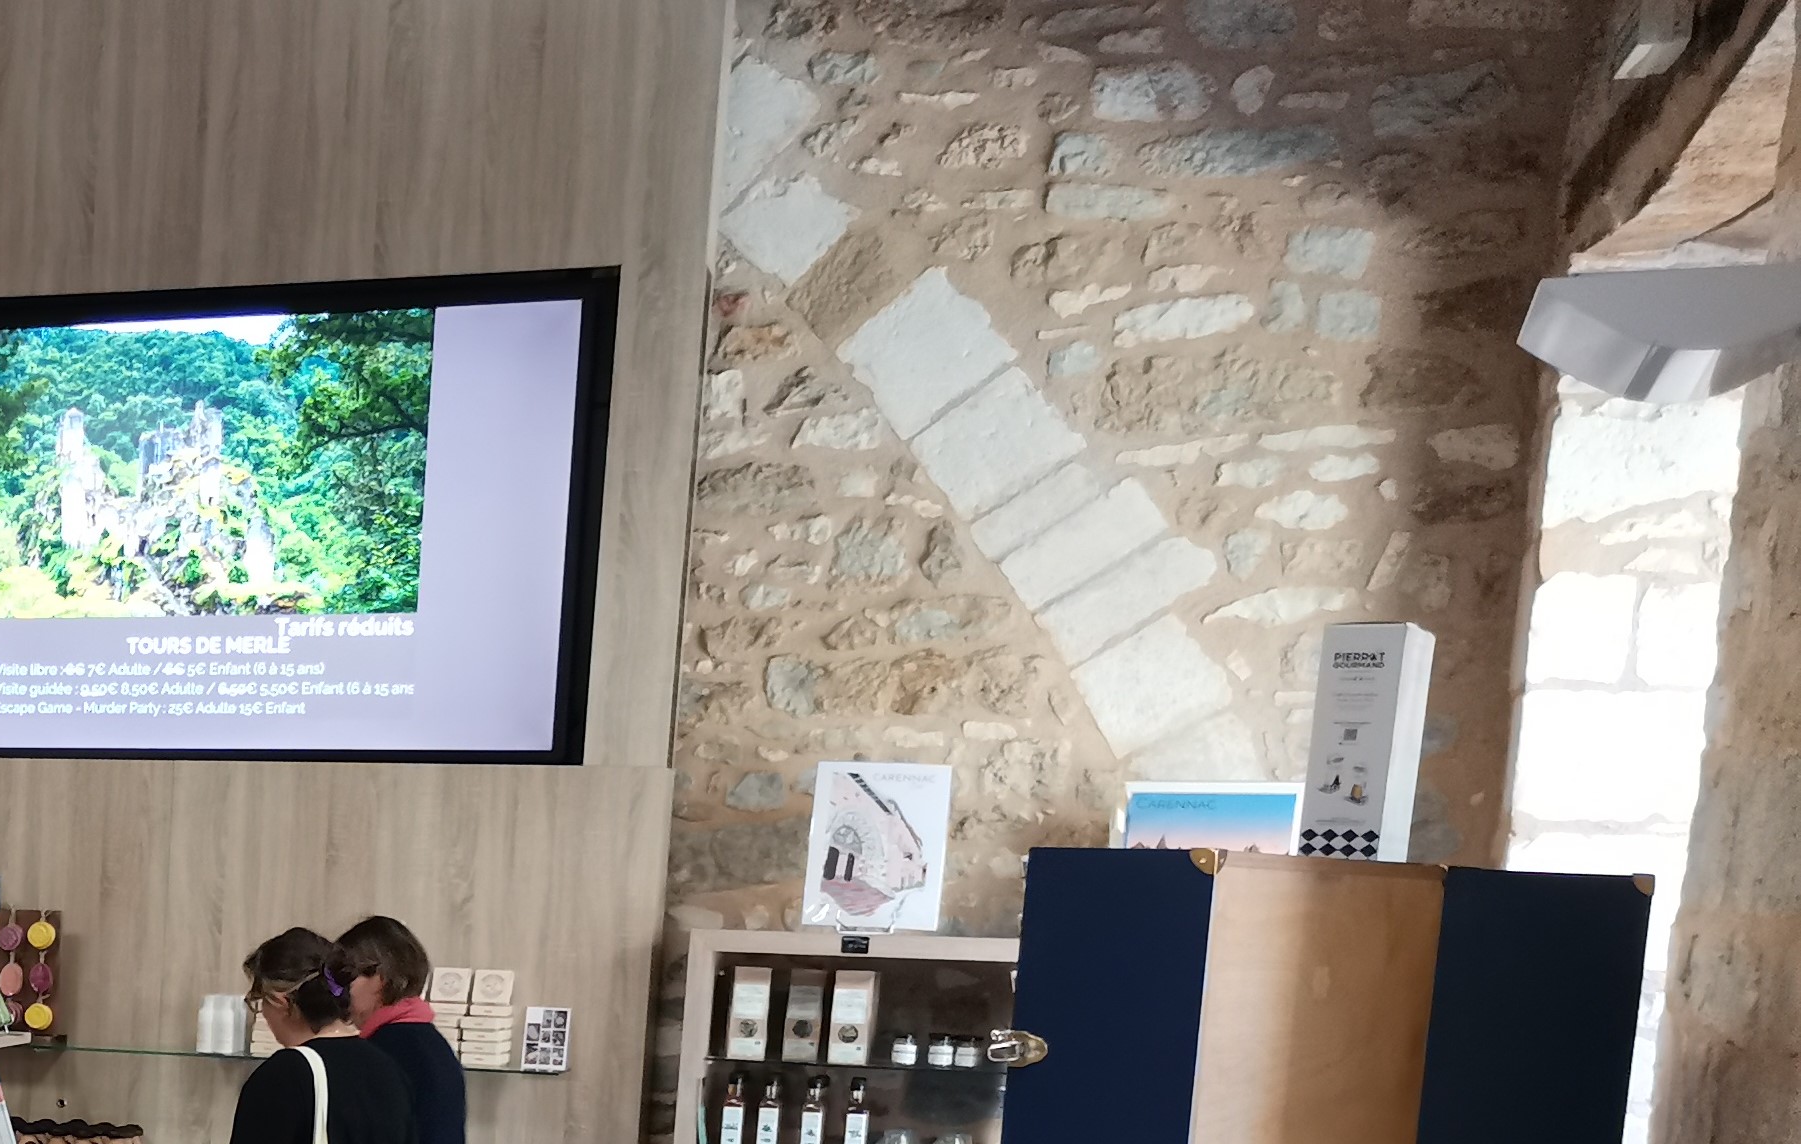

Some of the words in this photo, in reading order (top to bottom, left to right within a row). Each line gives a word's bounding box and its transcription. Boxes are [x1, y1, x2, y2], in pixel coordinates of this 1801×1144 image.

[274, 617, 334, 637] Tarifs
[338, 616, 415, 637] réduits
[126, 636, 192, 655] TOURS
[195, 636, 222, 654] DE
[225, 635, 291, 654] MERLE
[30, 662, 58, 676] libre
[87, 662, 106, 677] 7€
[108, 662, 151, 676] Adulte
[187, 662, 207, 677] 5€
[209, 661, 251, 676] Enfant
[280, 662, 295, 677] 15
[297, 661, 326, 677] ans)
[29, 681, 72, 698] guidée
[161, 682, 204, 696] Adulte
[301, 681, 345, 696] Enfant
[373, 681, 390, 697] 15
[37, 701, 73, 715] Game
[83, 701, 128, 715] Murder
[129, 701, 161, 717] Party
[167, 702, 193, 717] 25€
[195, 701, 236, 715] Adulte
[238, 702, 263, 717] 15€
[265, 701, 306, 715] Enfant
